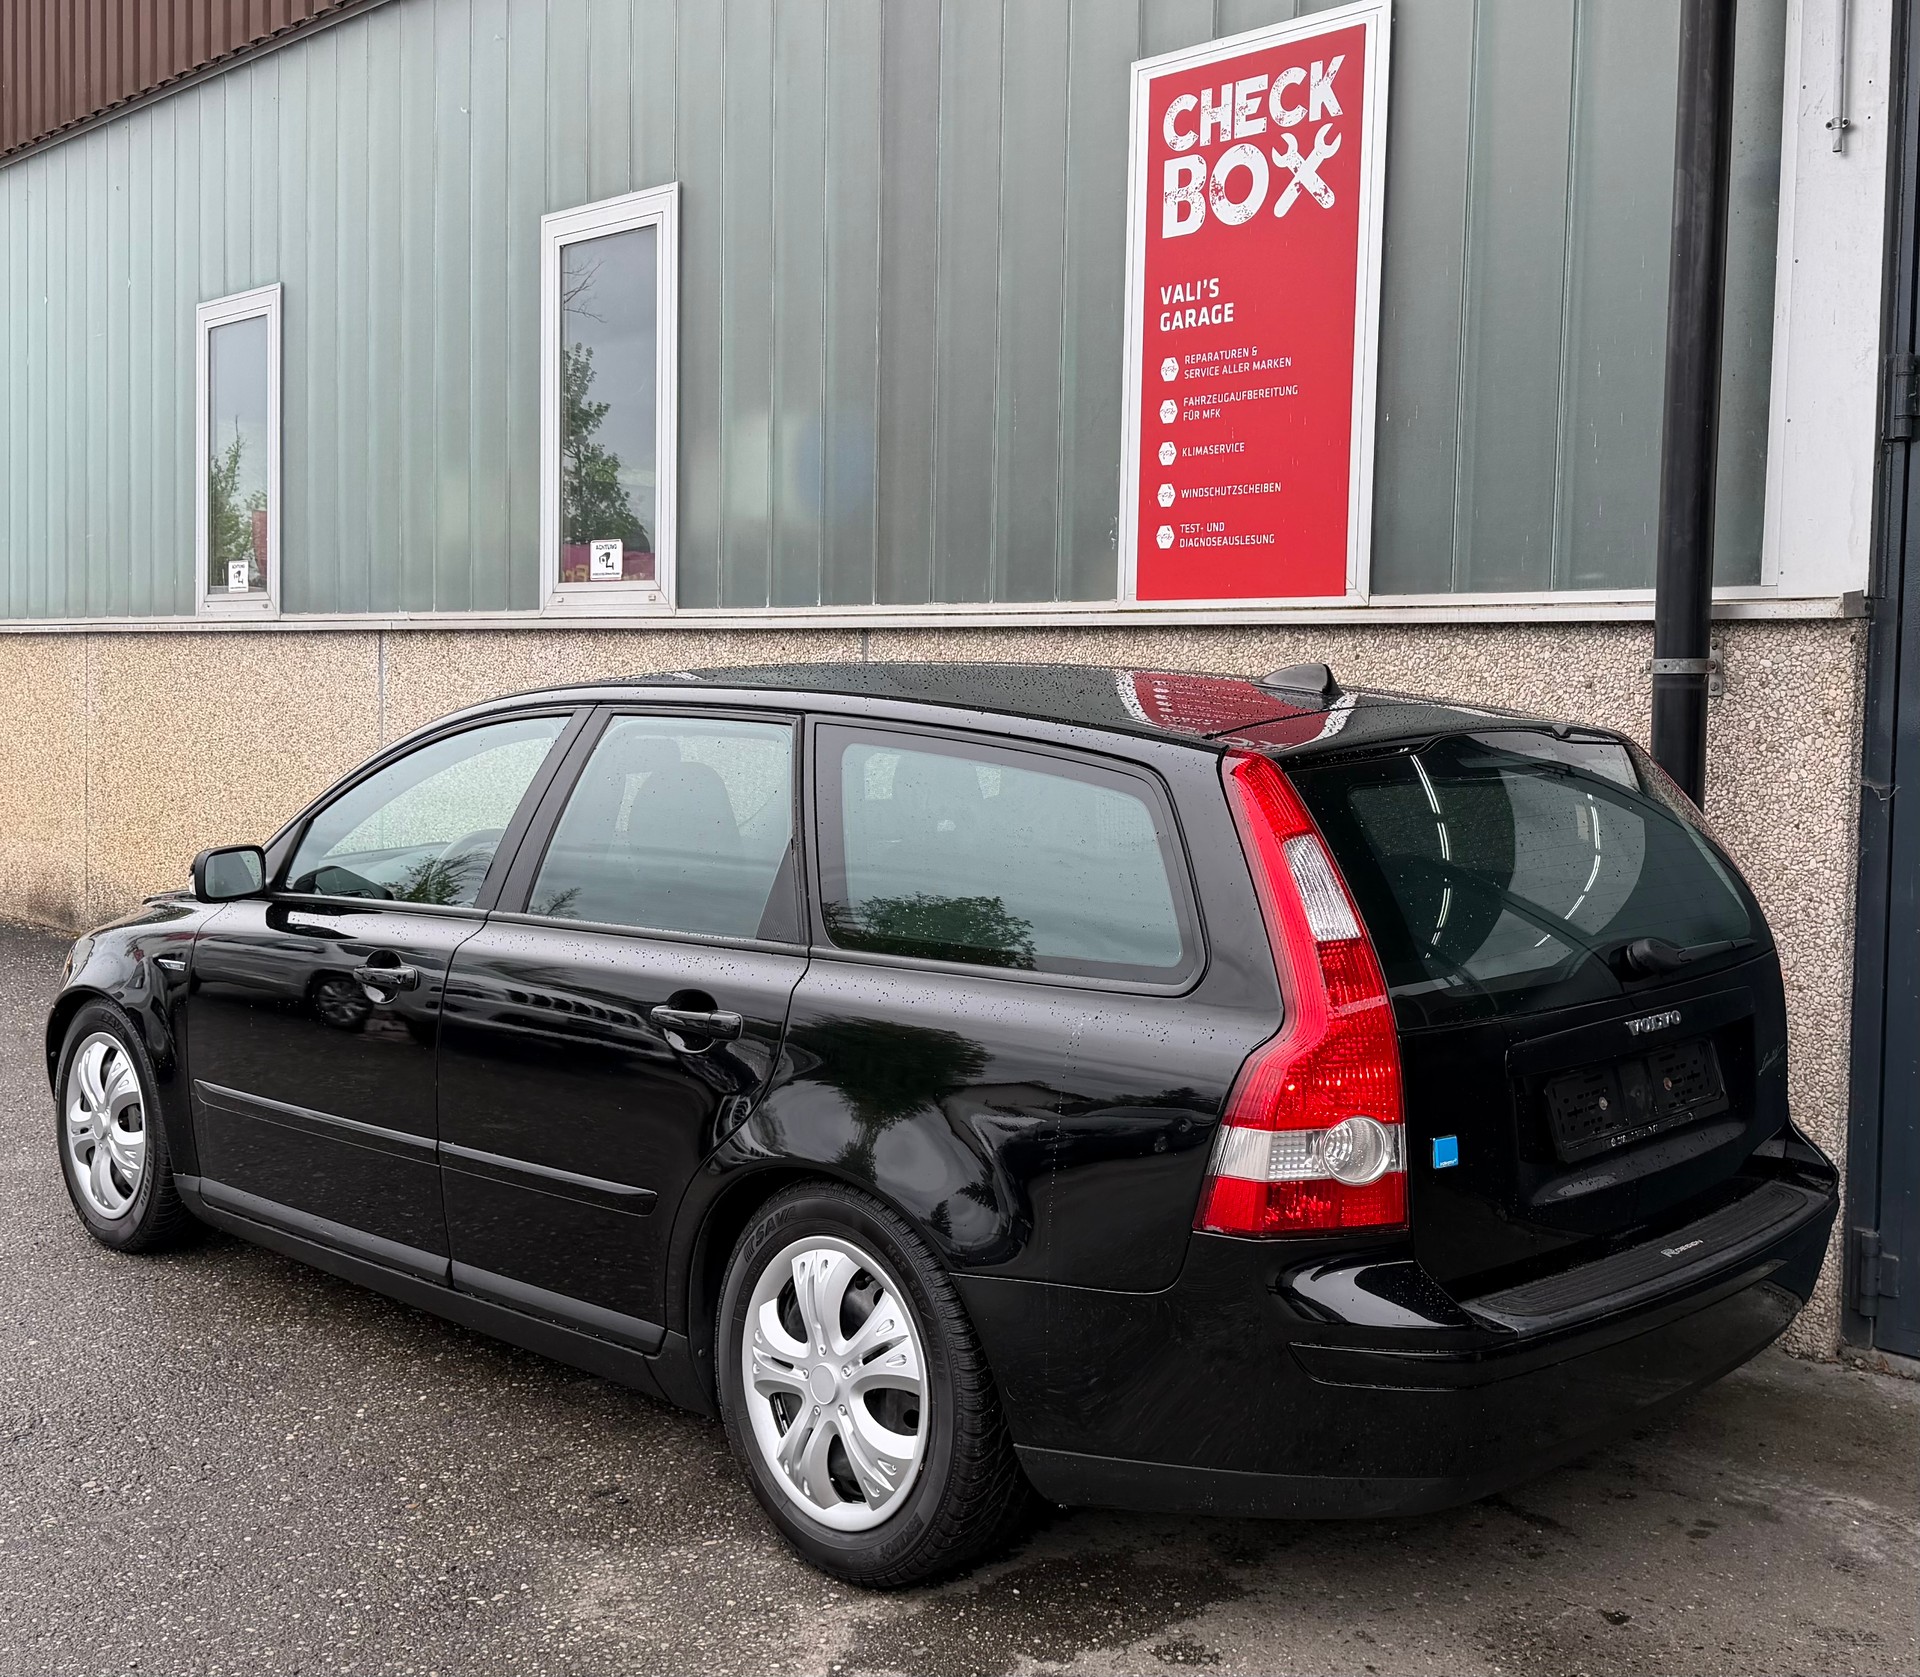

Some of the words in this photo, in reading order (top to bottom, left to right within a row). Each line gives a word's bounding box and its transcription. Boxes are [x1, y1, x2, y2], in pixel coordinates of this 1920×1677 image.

[1163, 55, 1345, 151] CHECK
[1162, 123, 1341, 239] BOX
[1161, 278, 1219, 305] VALI'S
[1160, 303, 1234, 331] GARAGE
[1185, 348, 1248, 364] REPARATUREN
[1251, 346, 1258, 356] &
[1184, 366, 1219, 379] SERVICE
[1222, 362, 1249, 374] ALLER
[1253, 357, 1291, 370] MARKEN
[1183, 384, 1299, 407] FAHRZEUGAUFBEREITUNG
[1184, 410, 1199, 421] FÜR
[1203, 409, 1220, 419] MFK
[1182, 442, 1244, 456] KLIMASERVICE
[1181, 483, 1281, 498] WINDSCHUTZSCHEIBEN
[1180, 524, 1203, 533] TEST-
[1207, 522, 1224, 532] UND
[1180, 534, 1274, 547] DIAGNOSEAUSLESUNG
[1624, 1010, 1682, 1036] VOLVO
[755, 1206, 796, 1247] SAVA
